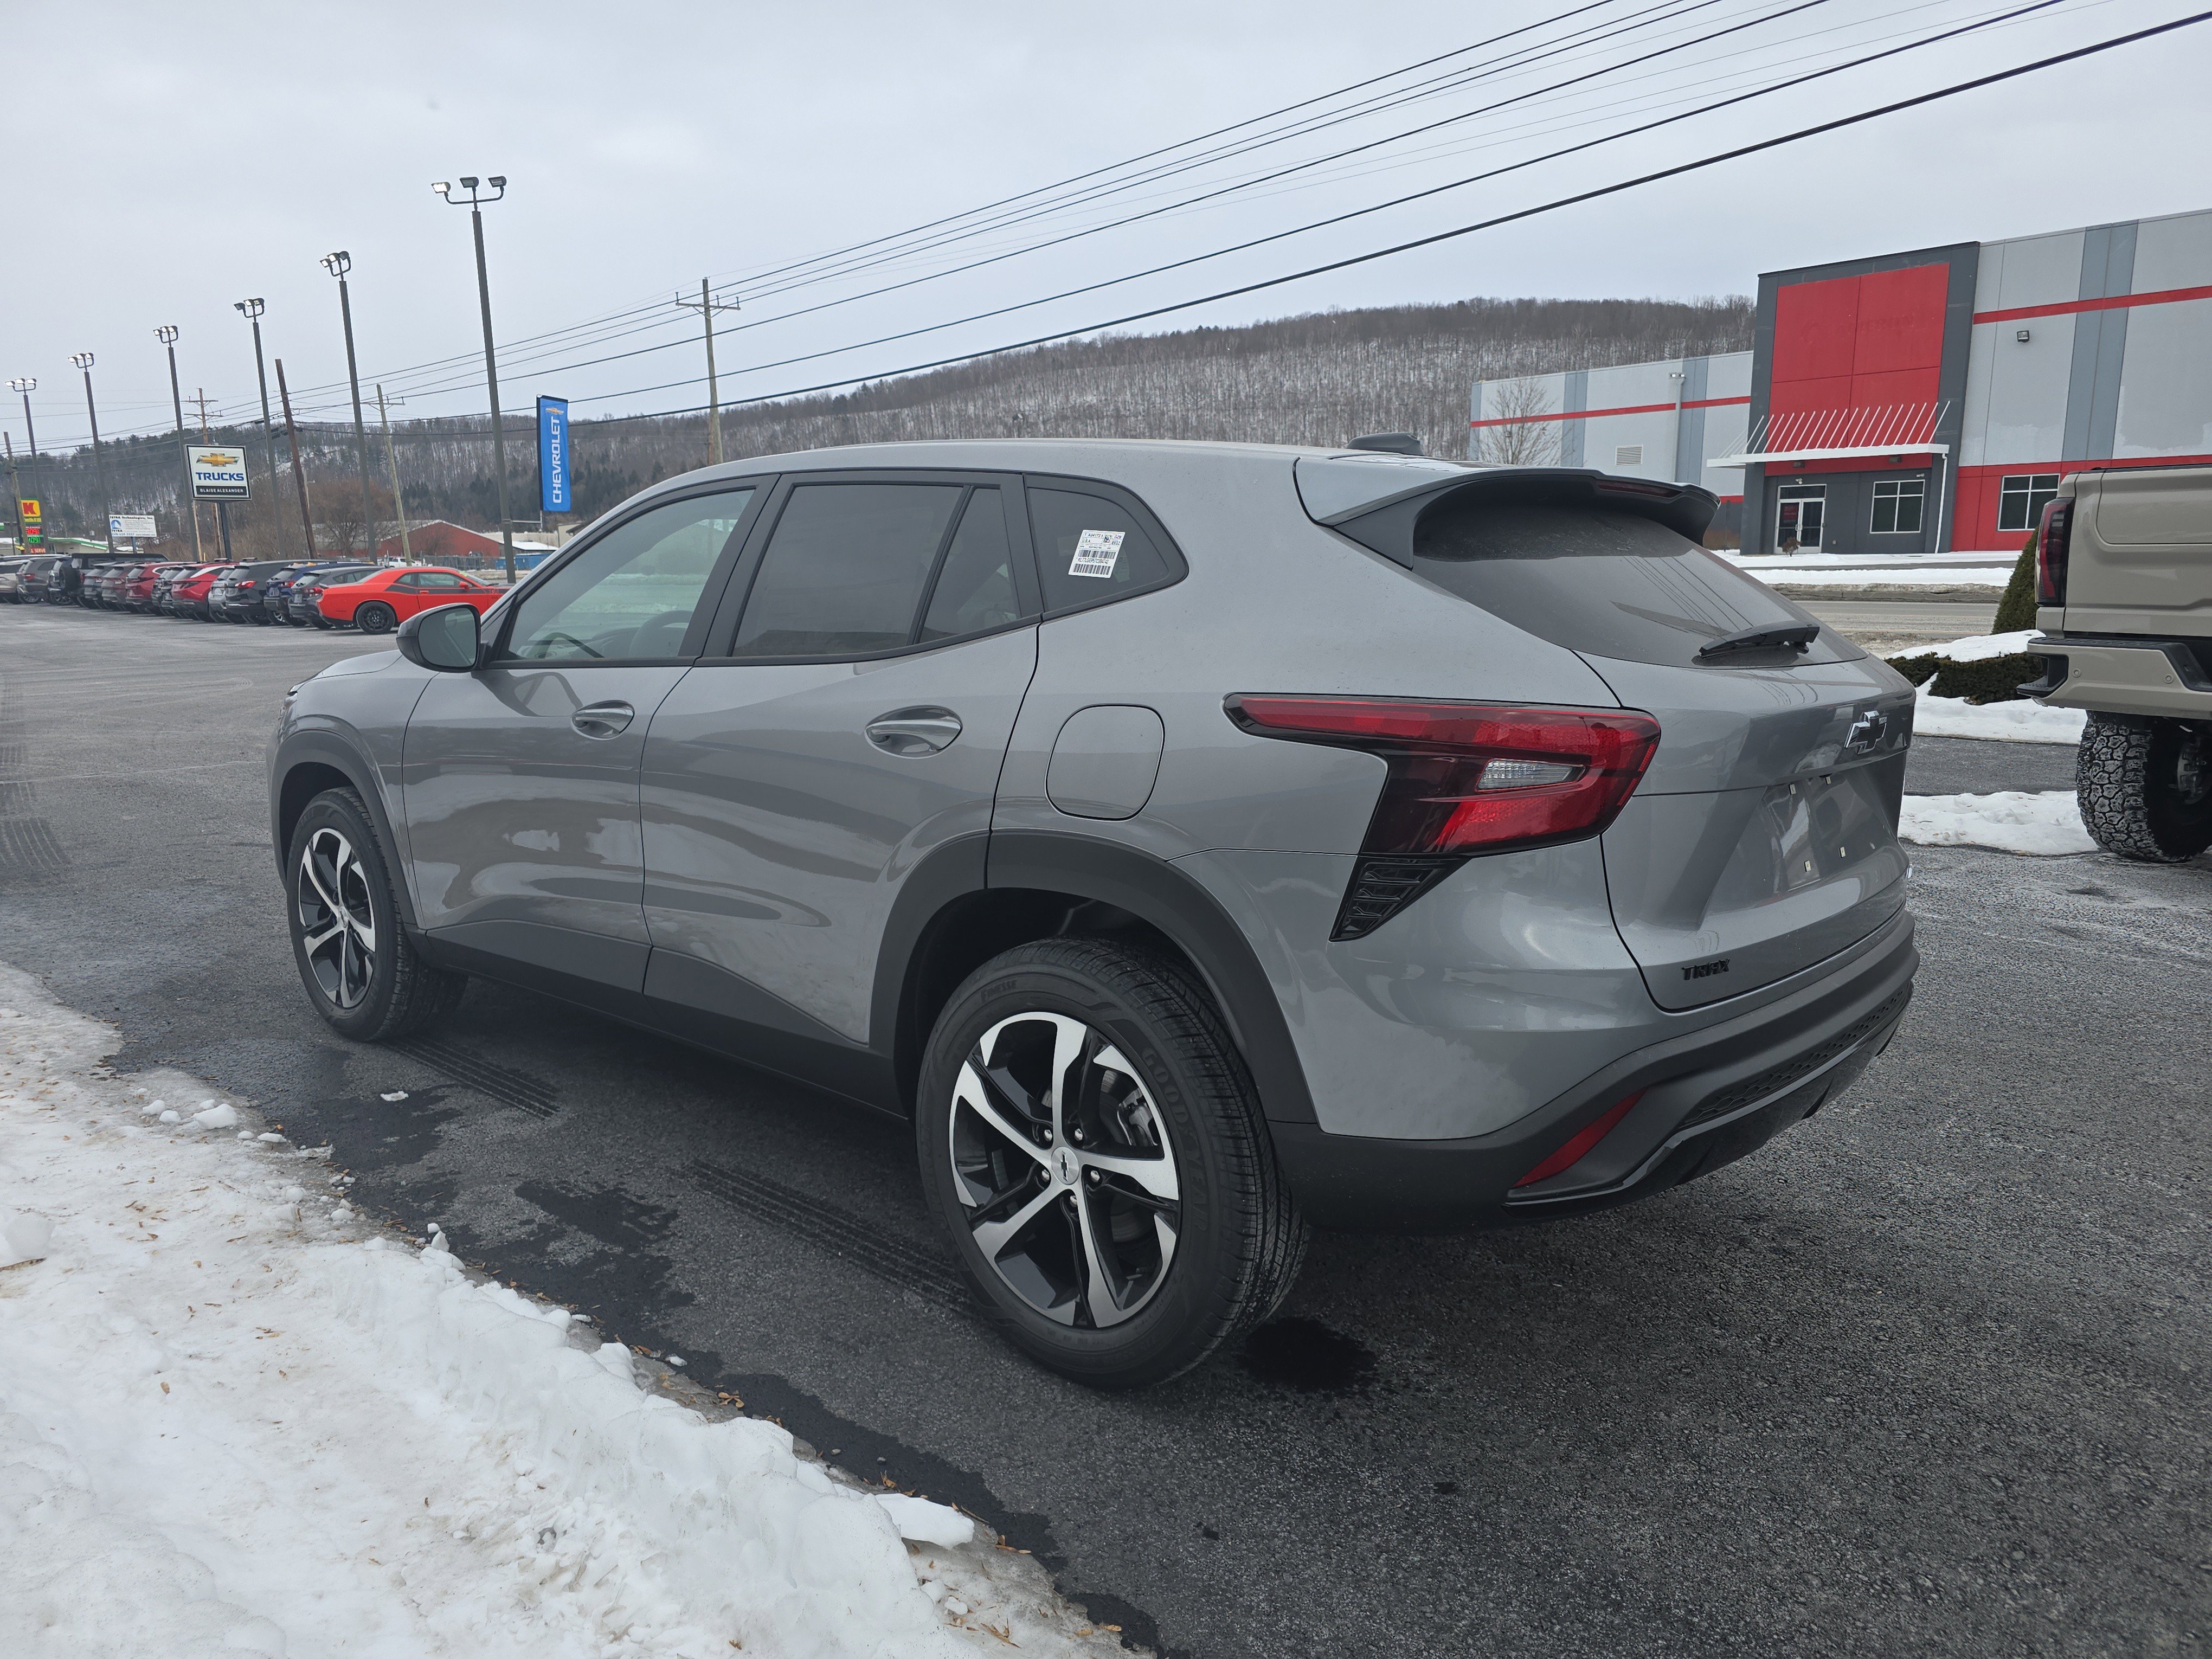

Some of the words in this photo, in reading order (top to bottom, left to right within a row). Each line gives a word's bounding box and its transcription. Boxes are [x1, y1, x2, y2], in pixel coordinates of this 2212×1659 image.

[195, 472, 245, 481] TRUCKS
[551, 415, 562, 504] CHEVROLET
[1681, 959, 1731, 981] TRAX
[1142, 1047, 1210, 1231] GOODYEAR
